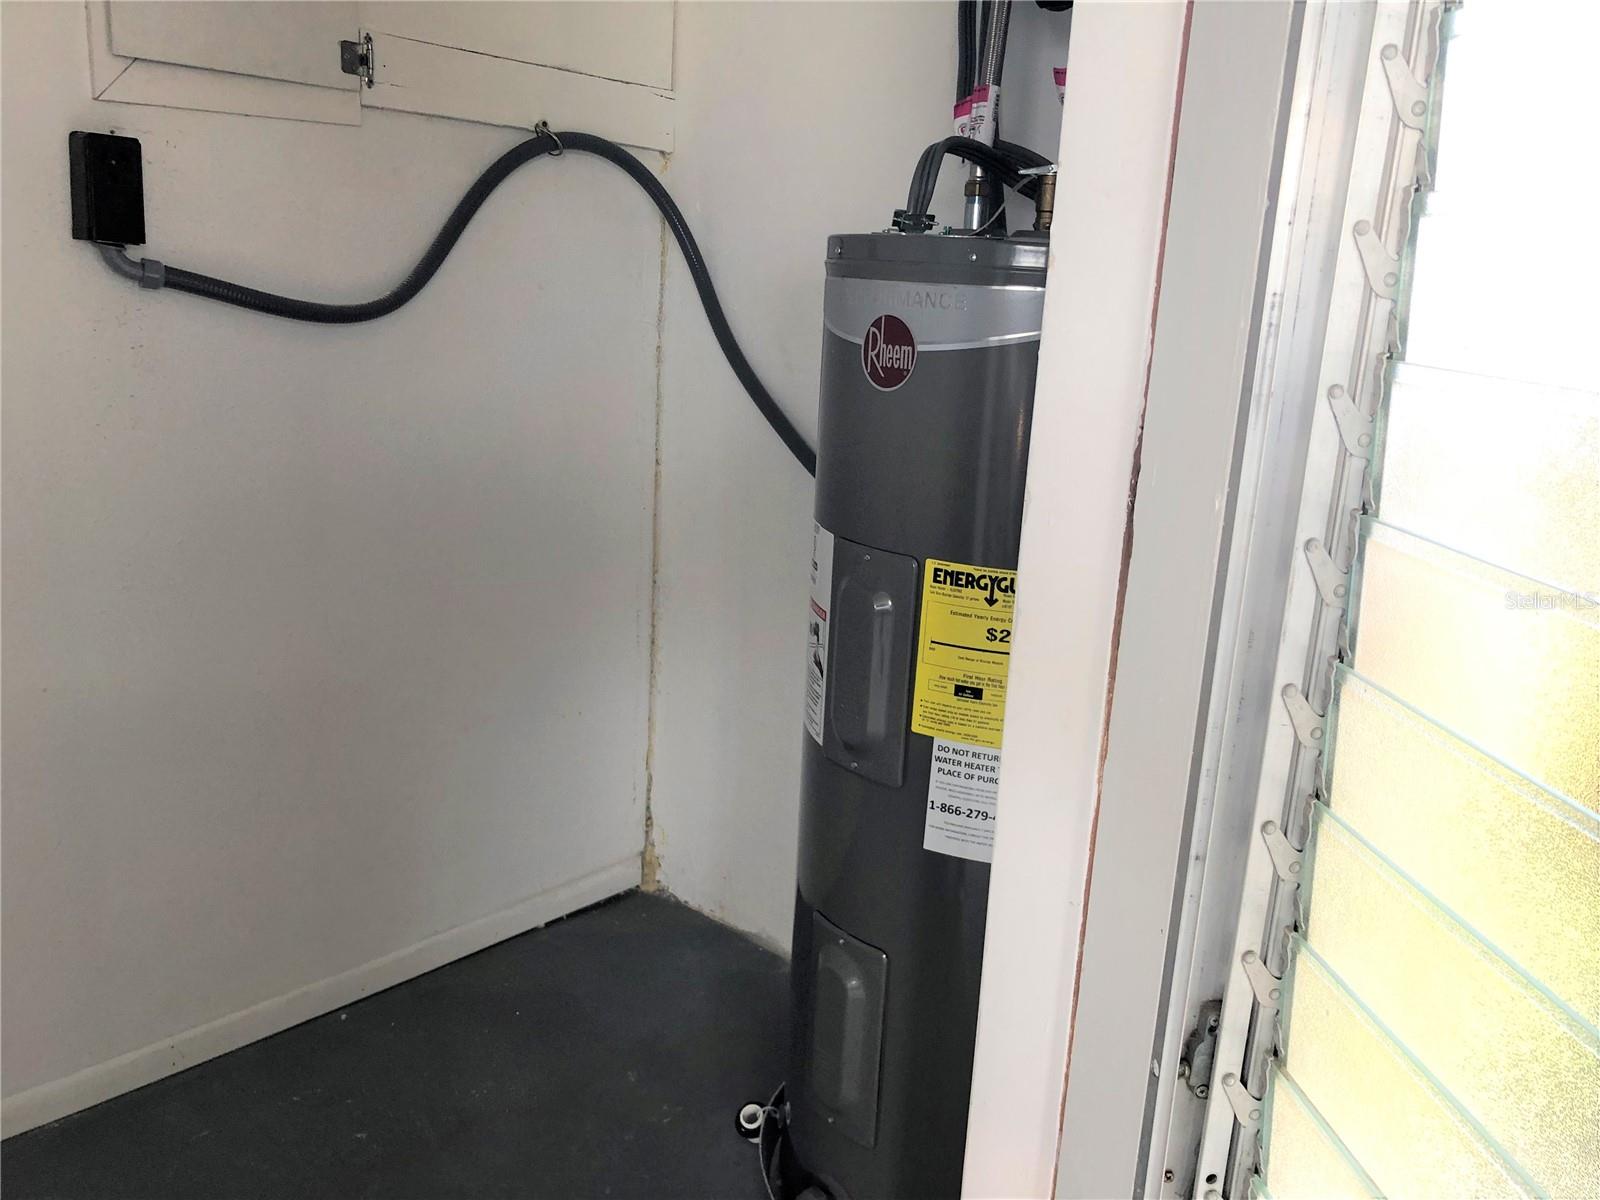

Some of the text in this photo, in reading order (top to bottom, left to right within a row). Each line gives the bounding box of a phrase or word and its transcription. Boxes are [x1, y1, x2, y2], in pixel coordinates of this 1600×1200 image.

[867, 315, 912, 377] Rheem
[949, 609, 973, 619] Estimated
[974, 613, 989, 621] Yearly
[937, 744, 1000, 763] DO NOT RETUR
[934, 754, 962, 768] WATER
[963, 761, 996, 774] HEATER
[937, 766, 962, 780] PLACE
[963, 772, 976, 782] OF
